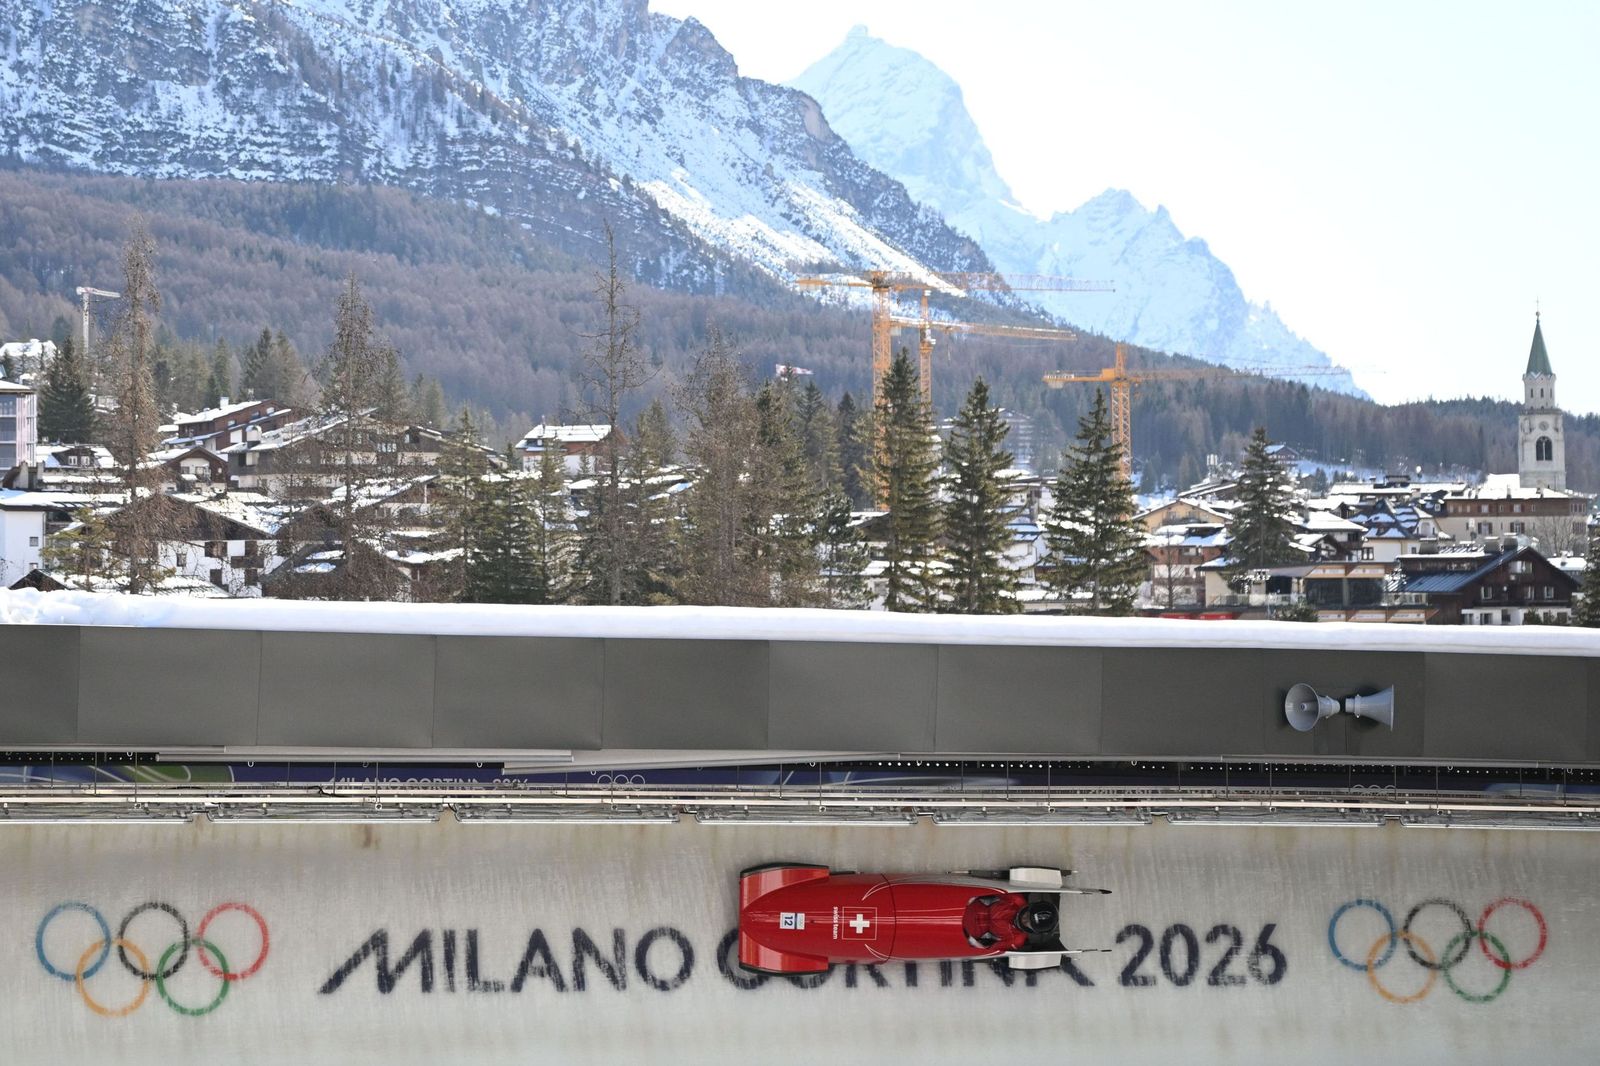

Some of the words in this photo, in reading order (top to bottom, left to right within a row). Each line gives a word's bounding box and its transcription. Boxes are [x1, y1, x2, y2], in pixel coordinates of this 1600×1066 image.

[784, 915, 793, 926] 12
[317, 926, 695, 994] MILANO
[1115, 923, 1288, 987] 2026
